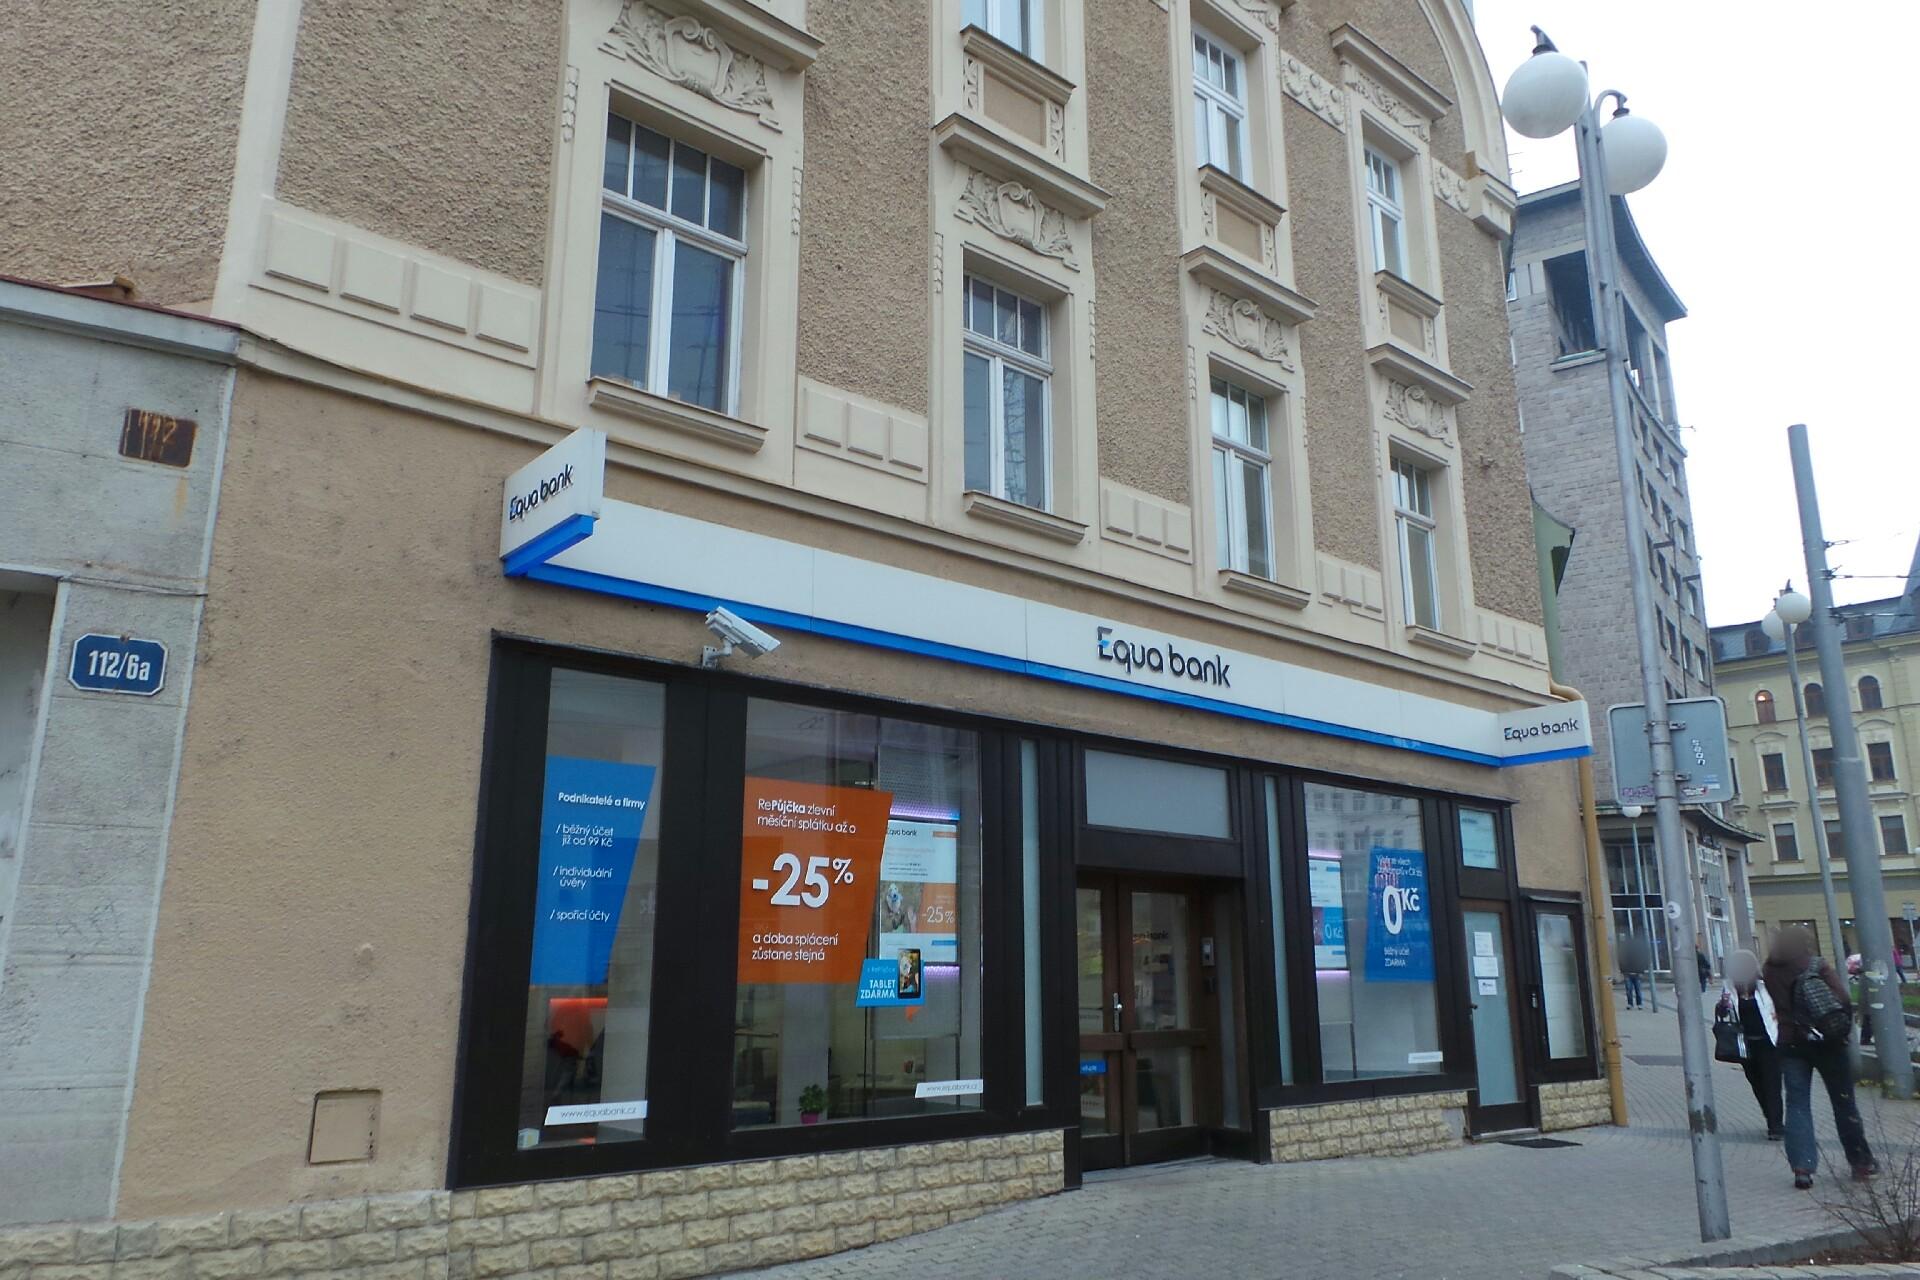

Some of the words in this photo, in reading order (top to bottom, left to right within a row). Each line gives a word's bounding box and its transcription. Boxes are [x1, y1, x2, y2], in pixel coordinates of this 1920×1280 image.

[509, 495, 539, 521] Equa
[540, 463, 574, 502] bank
[89, 650, 151, 681] 112/6a
[1097, 626, 1164, 674] Equa
[1168, 643, 1231, 688] bank
[1503, 727, 1539, 742] Equa
[1540, 718, 1579, 735] bank
[558, 791, 613, 806] Podnikatelé
[614, 798, 621, 807] a
[622, 797, 646, 811] firmy
[757, 798, 806, 814] RePůjčka
[807, 804, 836, 817] zlevní
[562, 824, 591, 836] běžný
[592, 825, 614, 836] účet
[757, 814, 797, 829] měsíční
[798, 817, 834, 832] splátku
[835, 821, 848, 833] až
[849, 825, 857, 834] o
[902, 827, 917, 836] bank
[573, 836, 587, 845] od
[588, 836, 600, 845] 99
[601, 837, 613, 848] Kč
[560, 866, 613, 879] individuální
[752, 852, 854, 908] -25%
[560, 877, 587, 890] úvěry
[752, 934, 761, 944] a
[763, 932, 793, 945] doba
[794, 932, 839, 947] splácení
[751, 946, 792, 961] zůstane
[794, 948, 825, 963] stejná
[868, 979, 896, 989] TABLET
[860, 989, 896, 1000] ZDARMA
